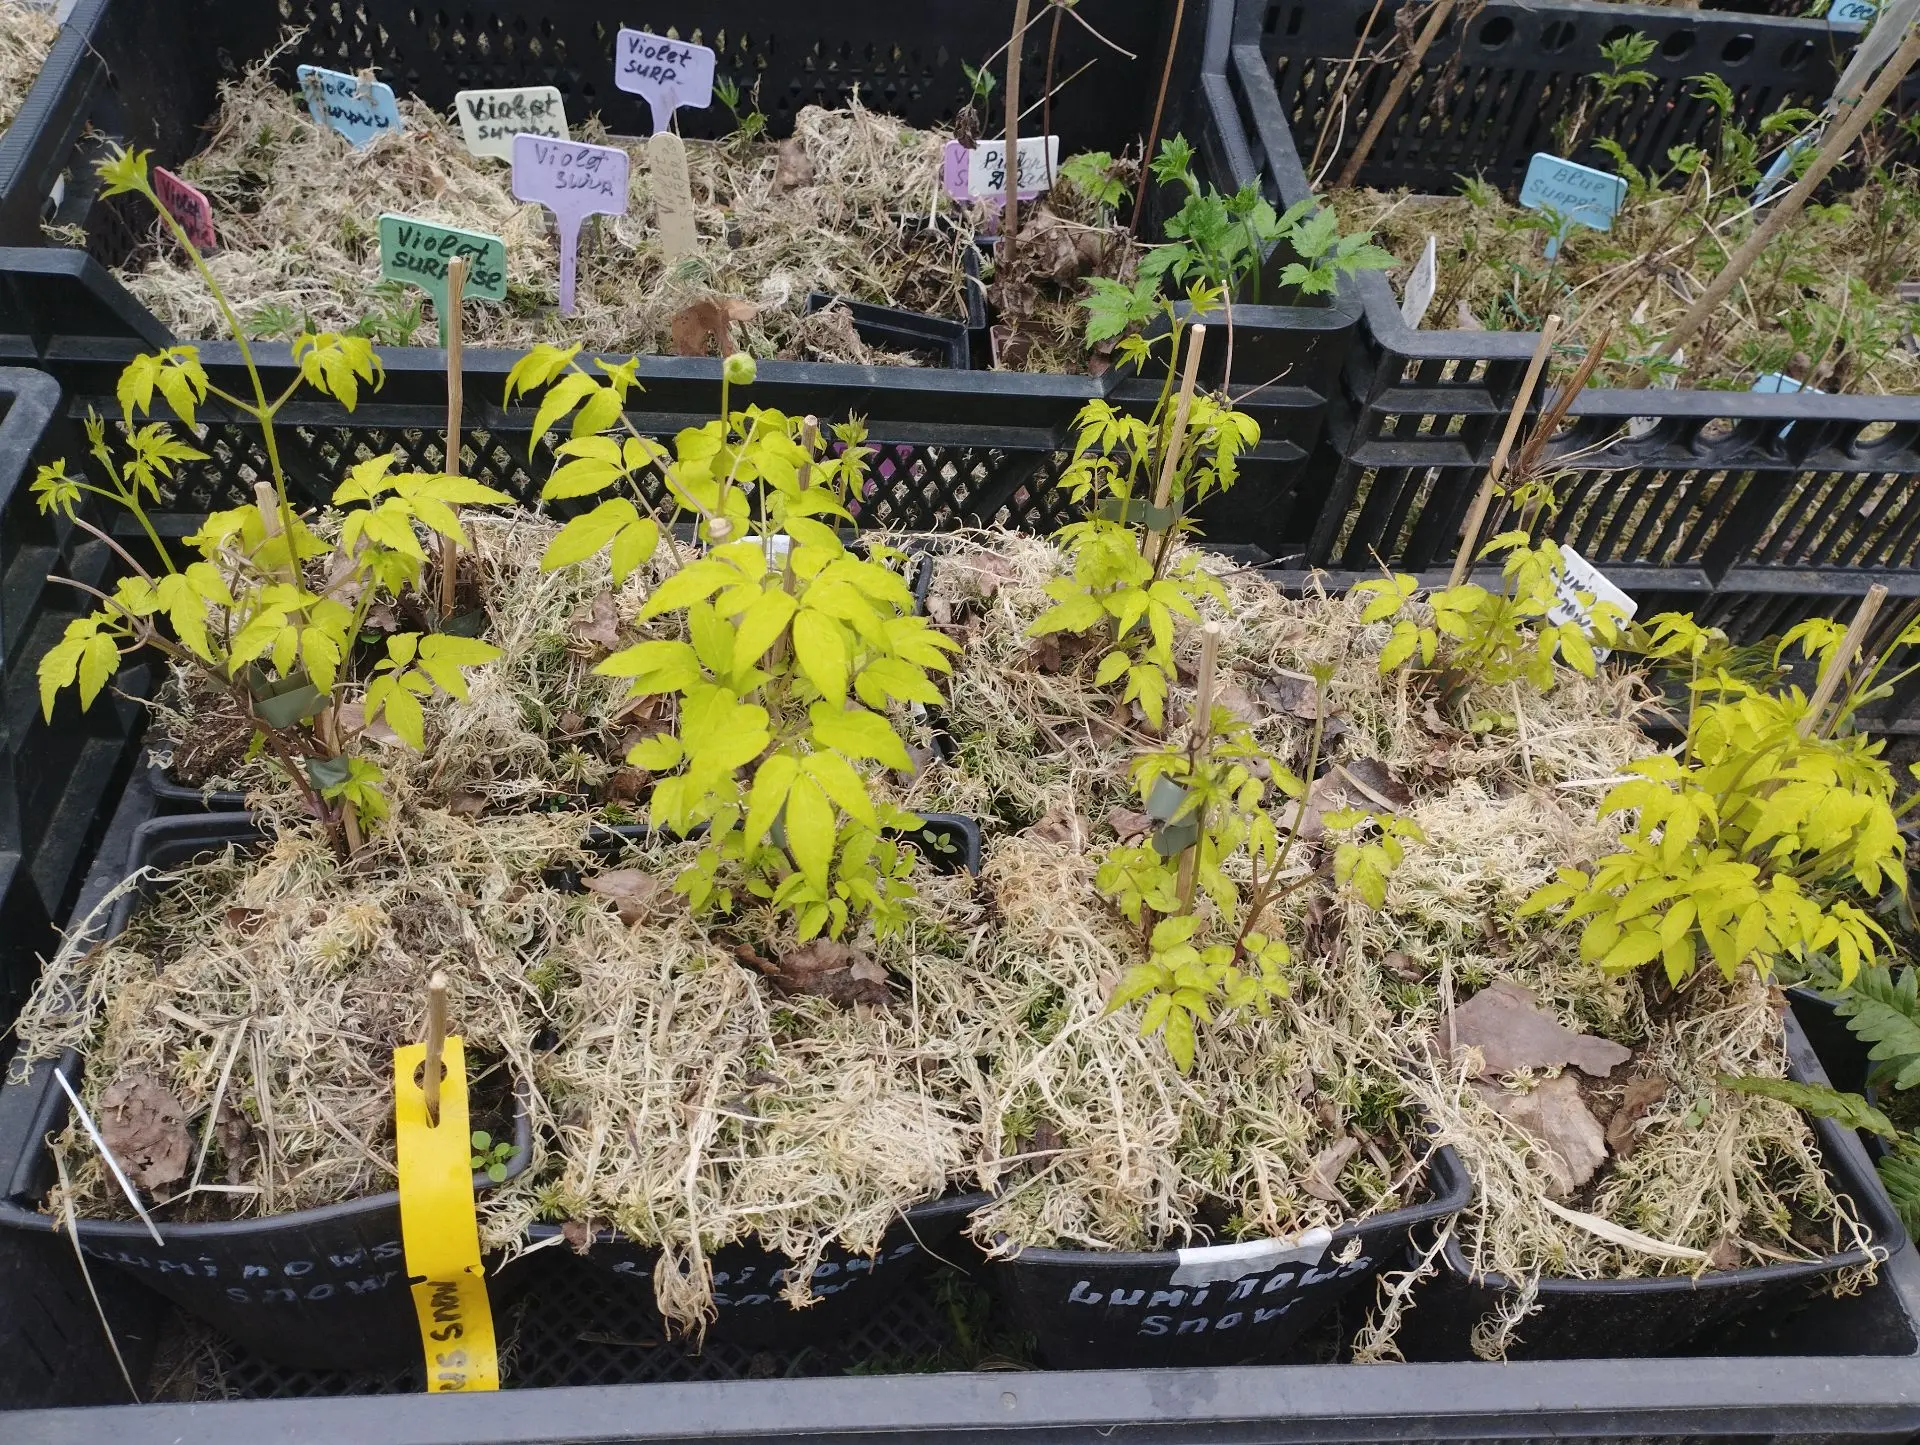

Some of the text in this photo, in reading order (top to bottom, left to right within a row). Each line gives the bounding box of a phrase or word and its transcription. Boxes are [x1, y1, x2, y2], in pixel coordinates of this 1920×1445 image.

[628, 37, 693, 68] Violet
[466, 93, 559, 122] Violet
[535, 143, 610, 173] Violet
[1552, 167, 1606, 193] Blue
[398, 226, 490, 266] Violet
